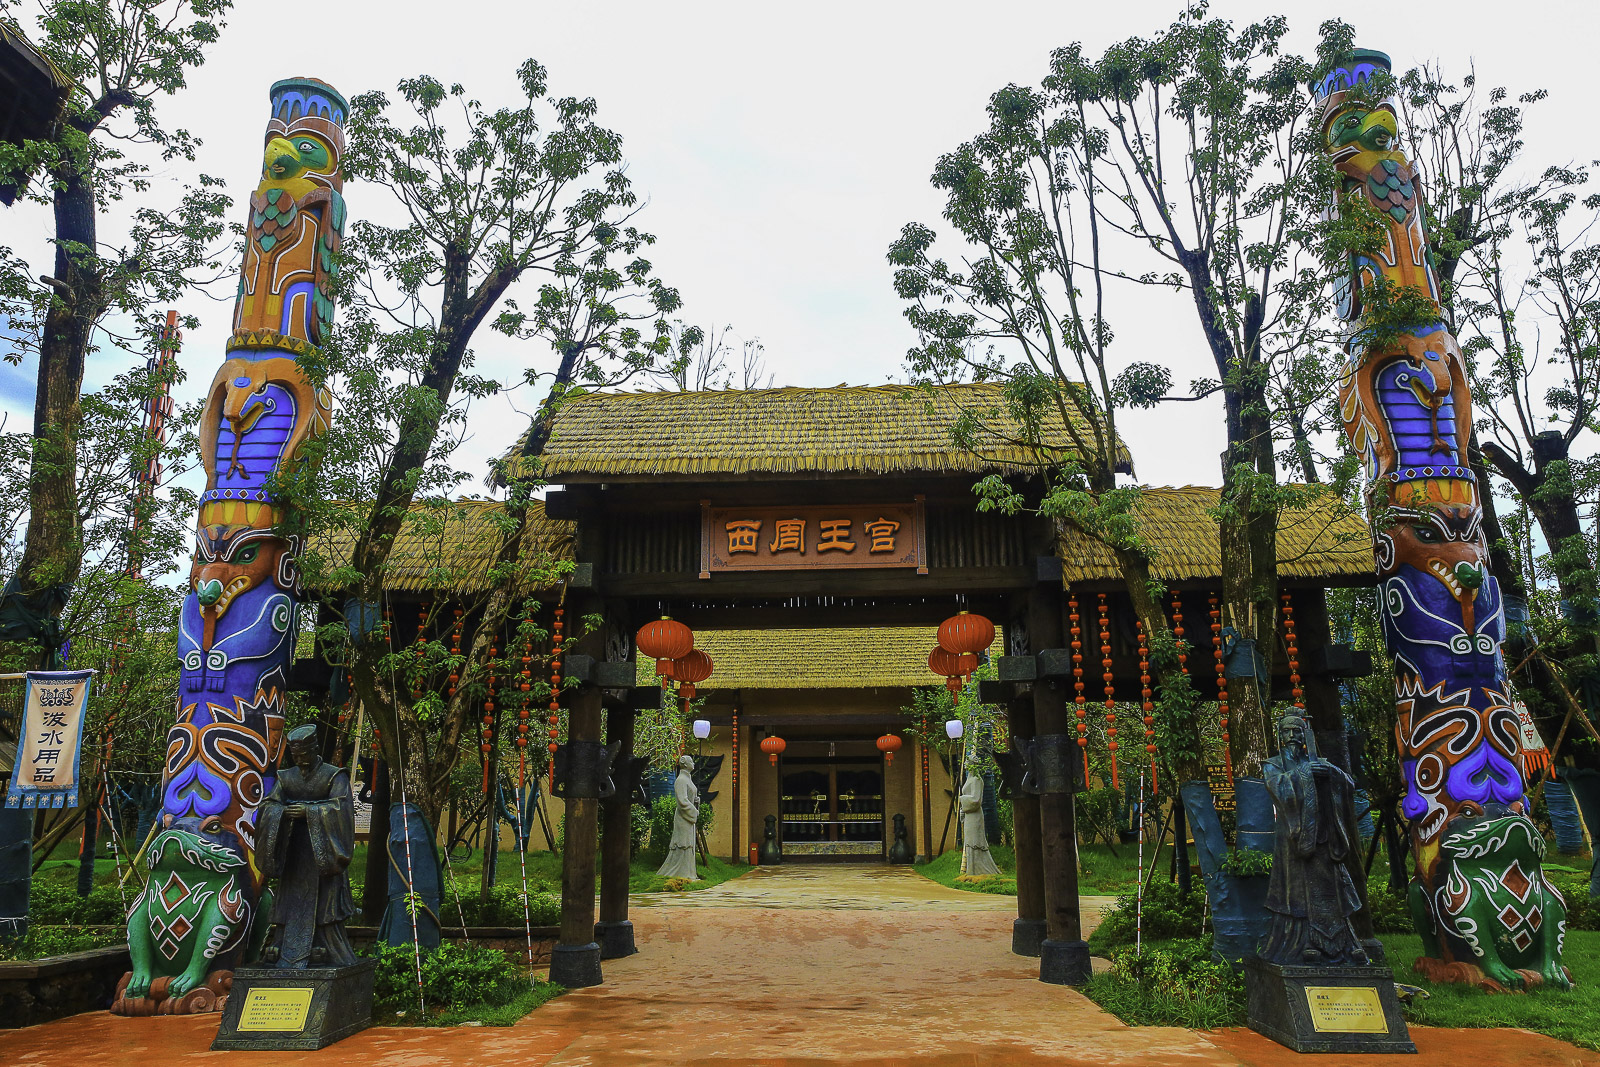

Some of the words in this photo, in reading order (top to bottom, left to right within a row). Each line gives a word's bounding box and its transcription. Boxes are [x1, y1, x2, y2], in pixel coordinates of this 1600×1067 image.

[725, 516, 902, 556] 西周王宫
[32, 711, 68, 783] 泼水用品
